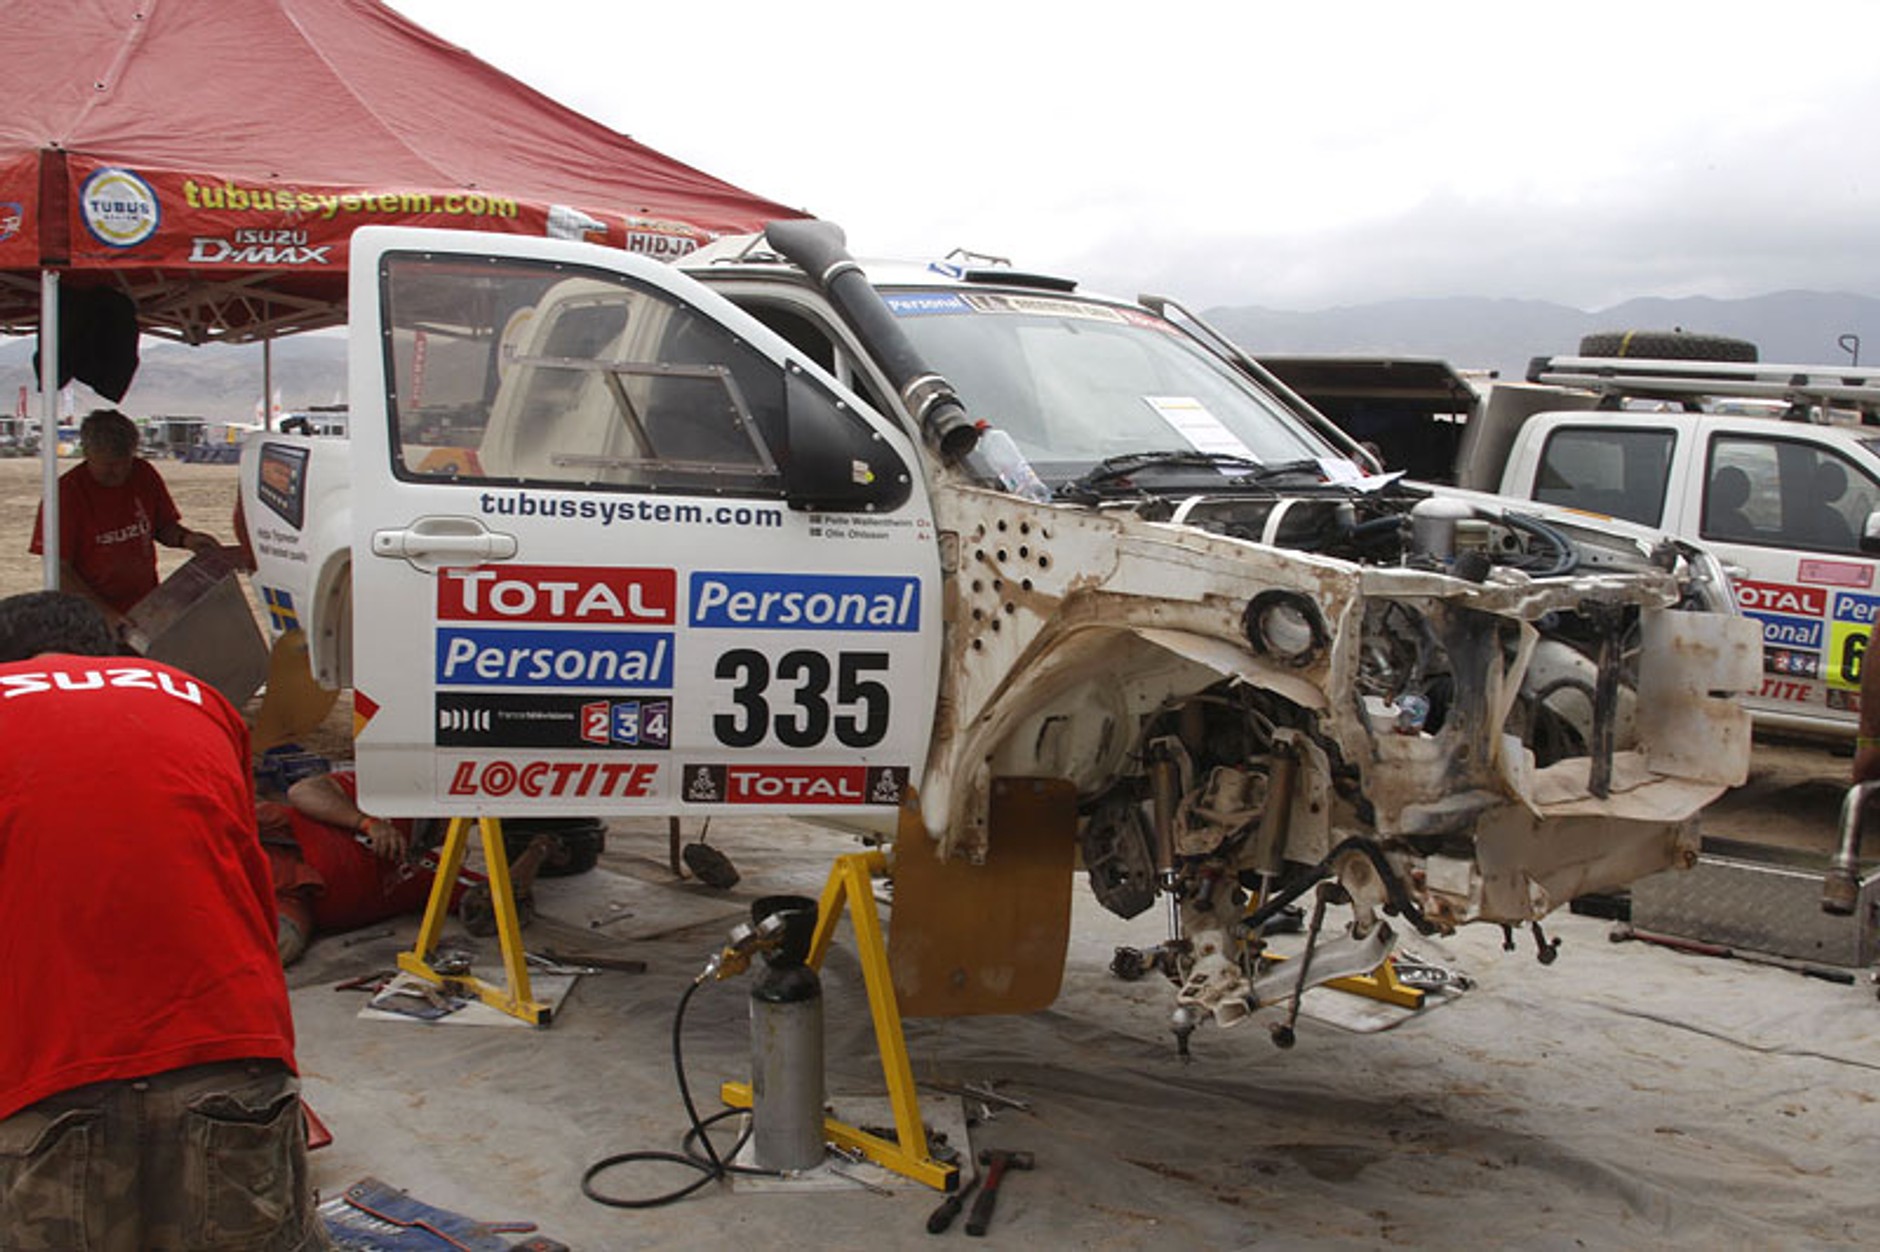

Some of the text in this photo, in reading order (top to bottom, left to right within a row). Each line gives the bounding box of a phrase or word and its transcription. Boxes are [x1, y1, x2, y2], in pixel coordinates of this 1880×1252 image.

[91, 201, 150, 214] TUBUS
[183, 180, 519, 219] tubussystem.com
[235, 229, 308, 245] ISUZU
[480, 492, 783, 527] tubussystem.com
[447, 568, 667, 617] TOTAL
[695, 580, 914, 626] Personal
[1734, 583, 1820, 613] OTAL
[443, 637, 667, 681] Personal
[712, 648, 890, 749] 335
[1747, 679, 1812, 702] TITE
[588, 712, 610, 738] 2
[618, 713, 639, 738] 3
[646, 714, 668, 740] 4
[448, 760, 659, 798] LOCTITE
[730, 772, 862, 798] TOTAL
